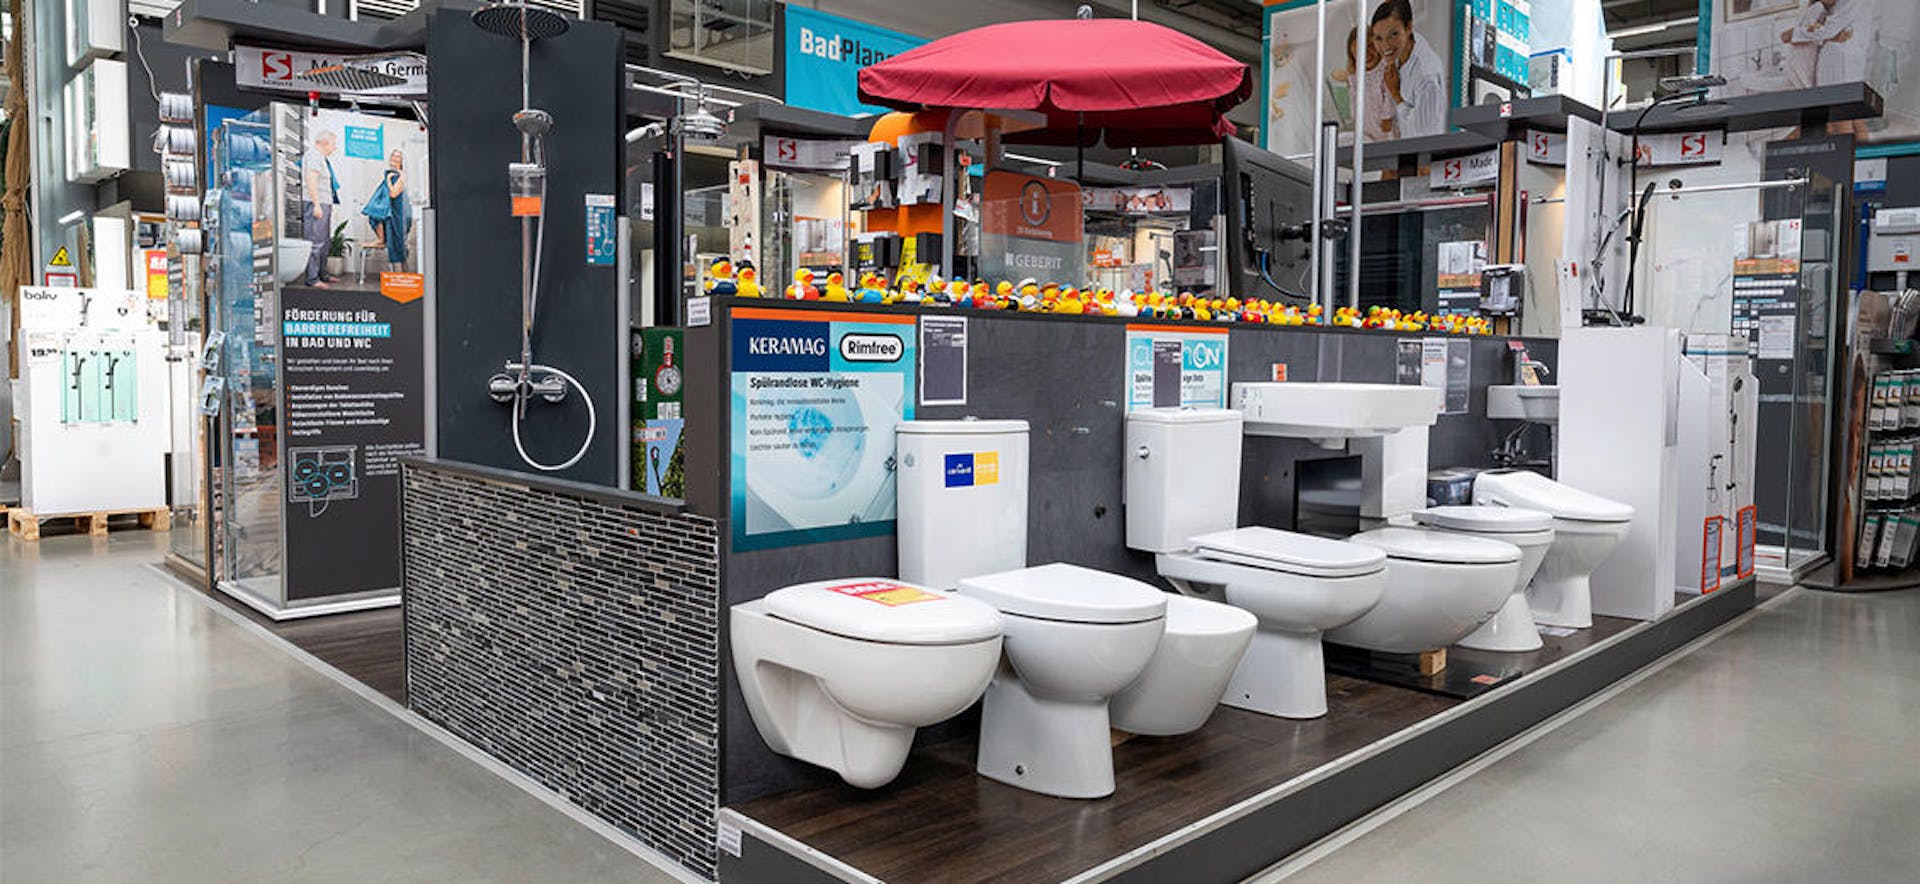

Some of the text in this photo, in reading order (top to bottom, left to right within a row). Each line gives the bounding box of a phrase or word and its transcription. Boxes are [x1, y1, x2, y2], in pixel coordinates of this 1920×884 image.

[801, 27, 893, 67] BadPlan
[386, 62, 428, 77] Germ
[1015, 253, 1062, 269] GEBERIT
[285, 308, 377, 322] FÖRDERUNG FÜR
[285, 323, 389, 336] BARRIEREFREIHEIT
[285, 337, 372, 349] IN BAD UND WC
[749, 336, 826, 356] KERAMAG
[750, 377, 859, 390] Spülrandlose WC-Hygiene
